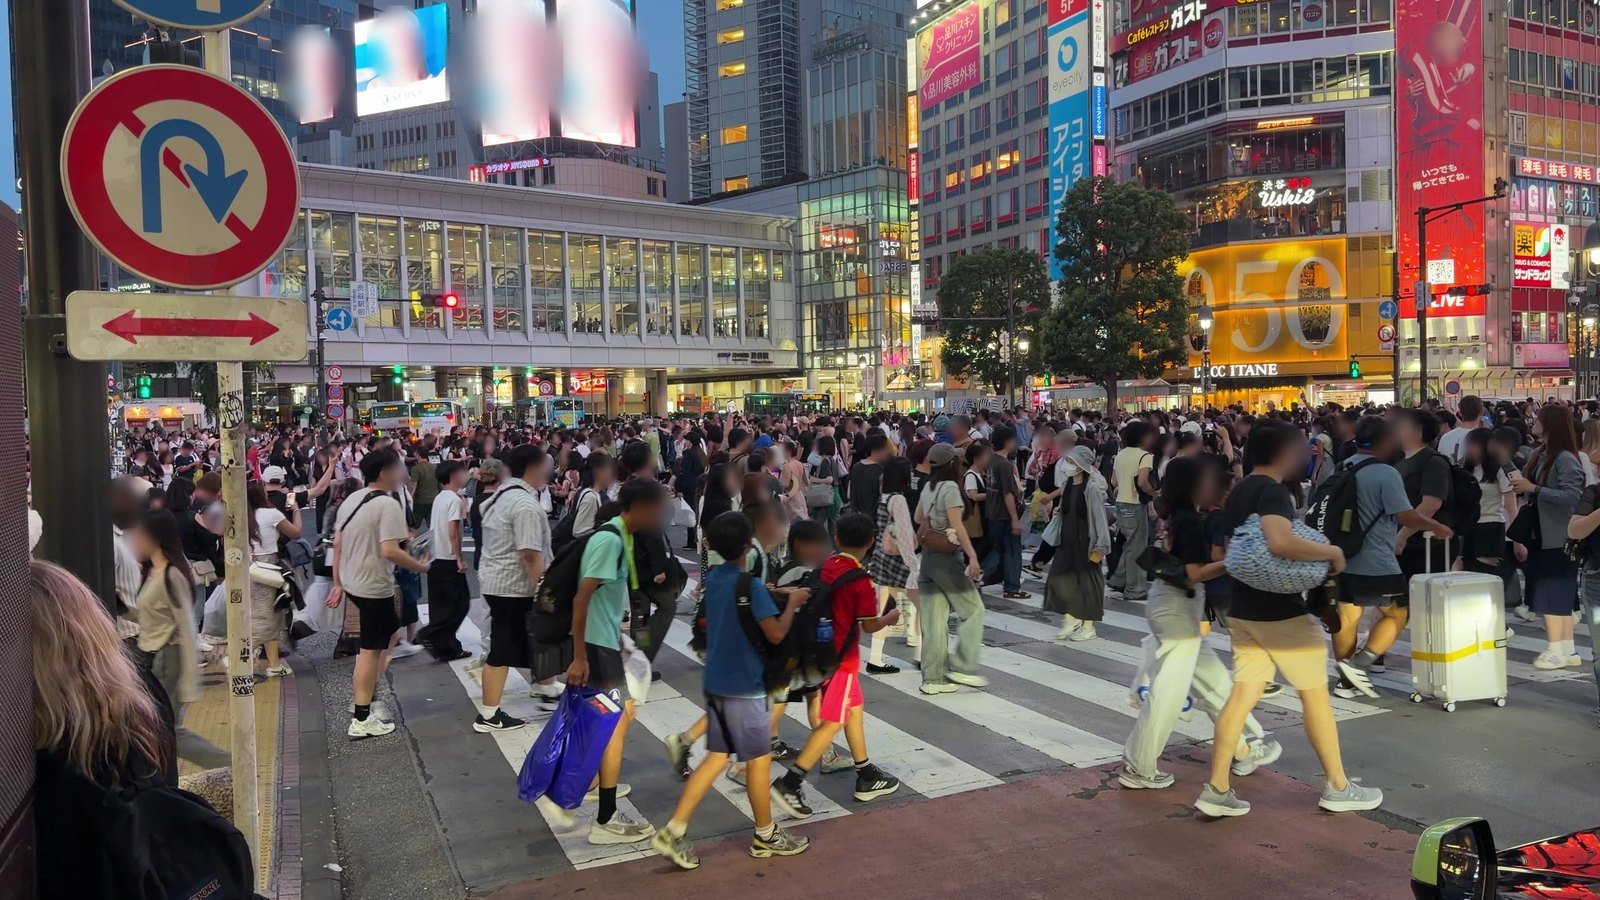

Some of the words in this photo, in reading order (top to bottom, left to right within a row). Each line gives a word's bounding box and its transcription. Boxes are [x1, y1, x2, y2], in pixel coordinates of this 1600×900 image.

[1171, 0, 1207, 31] ガスト
[944, 13, 976, 40] 品川スキン
[1207, 31, 1222, 42] ガスト
[945, 29, 973, 54] クリニック
[1154, 35, 1197, 72] ガスト
[928, 61, 976, 99] 品川美容外科
[1052, 71, 1083, 92] eyecity
[486, 163, 510, 173] カラオケ
[1421, 164, 1457, 178] いつでも
[1523, 160, 1542, 174] 薄毛
[1549, 163, 1567, 177] 抜毛
[1574, 167, 1591, 180] 発毛
[1412, 173, 1470, 191] 帰ってきてね。
[1258, 188, 1316, 207] Ushi8
[1511, 182, 1557, 210] AGA
[1514, 269, 1551, 281] サンドラッグ
[1231, 257, 1343, 353] 50
[1194, 363, 1278, 379] L'CCITANE
[1317, 500, 1328, 532] KELME
